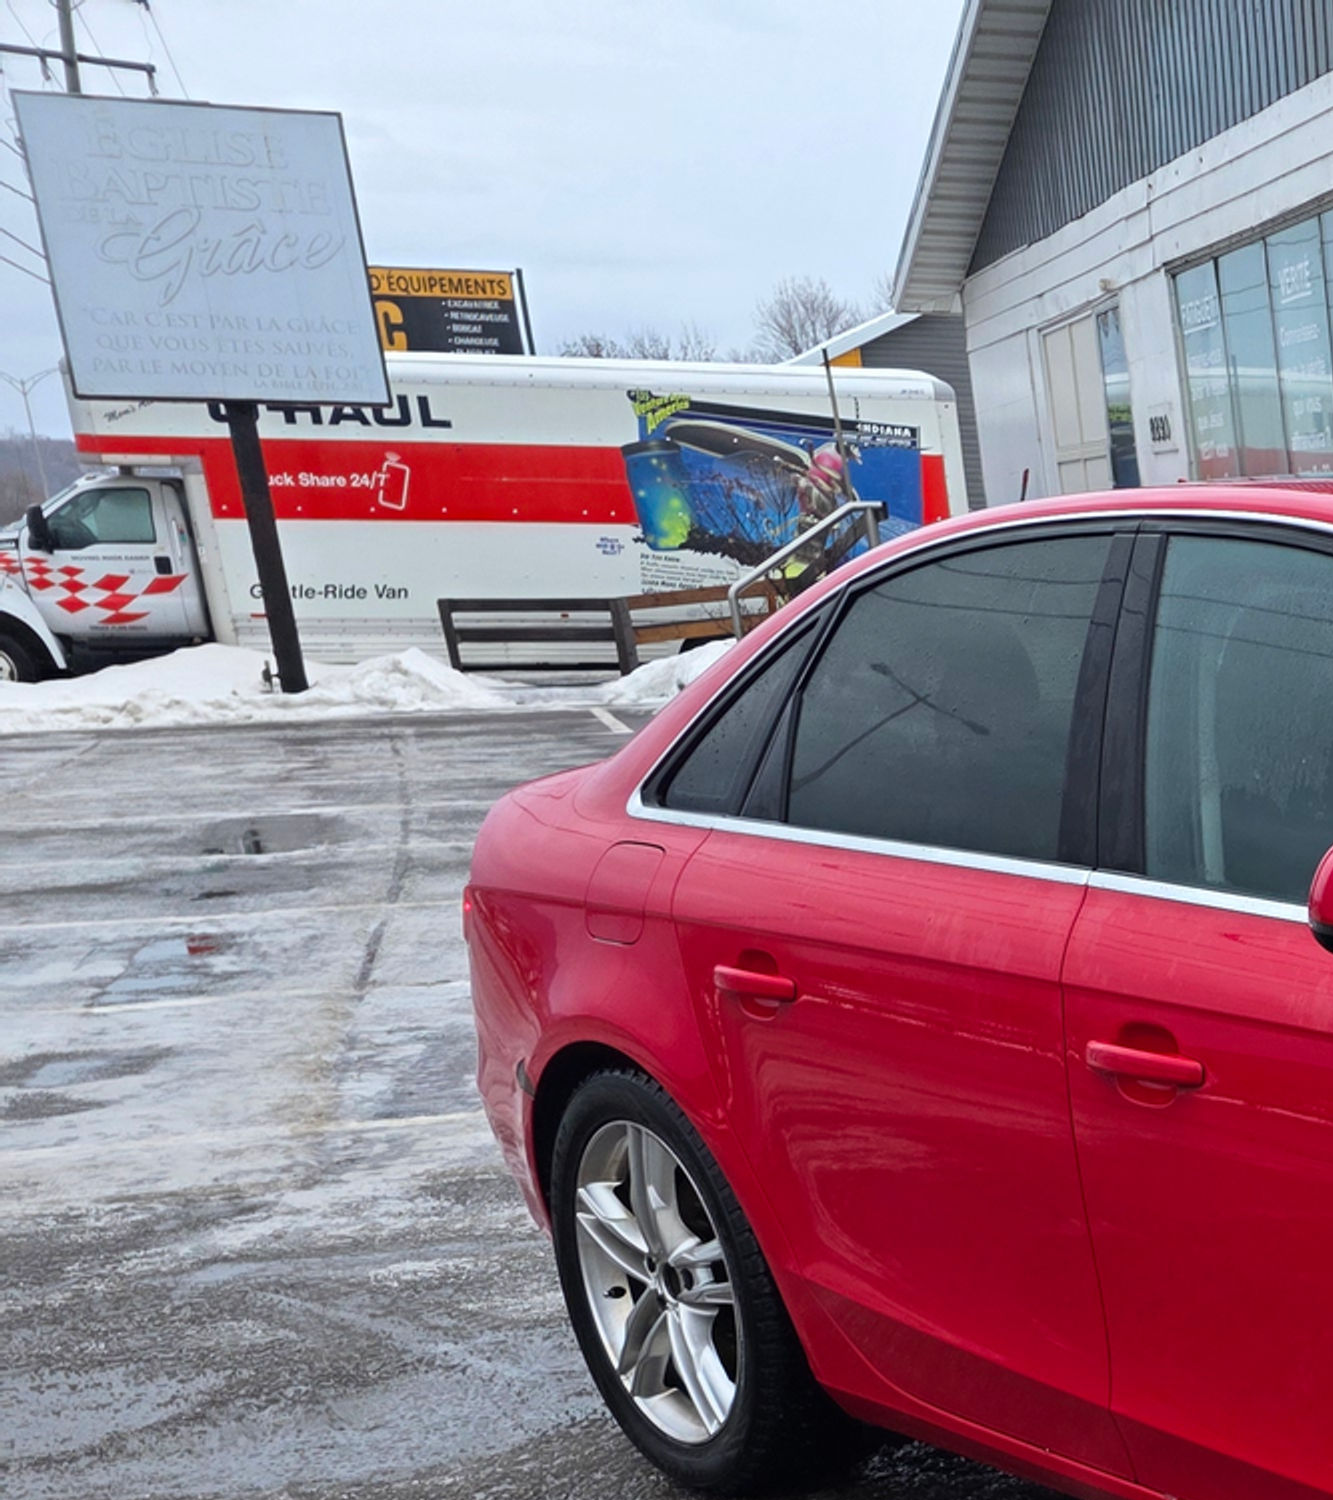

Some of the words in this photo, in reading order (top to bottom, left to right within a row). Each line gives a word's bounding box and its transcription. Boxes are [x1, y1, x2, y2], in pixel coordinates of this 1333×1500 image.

[58, 160, 331, 216] BAPTISTE
[97, 207, 346, 307] Grâce
[209, 313, 249, 331] PAR
[256, 317, 280, 333] LA
[96, 334, 142, 352] QUE
[149, 335, 209, 352] VOUS
[92, 357, 133, 374] PAR
[140, 359, 163, 375] LE
[170, 360, 249, 377] MOYEN
[258, 363, 285, 378] DE
[293, 364, 320, 379] LA
[298, 472, 347, 487] Share
[250, 584, 367, 599] Gtle-Ride
[374, 584, 408, 599] Van
